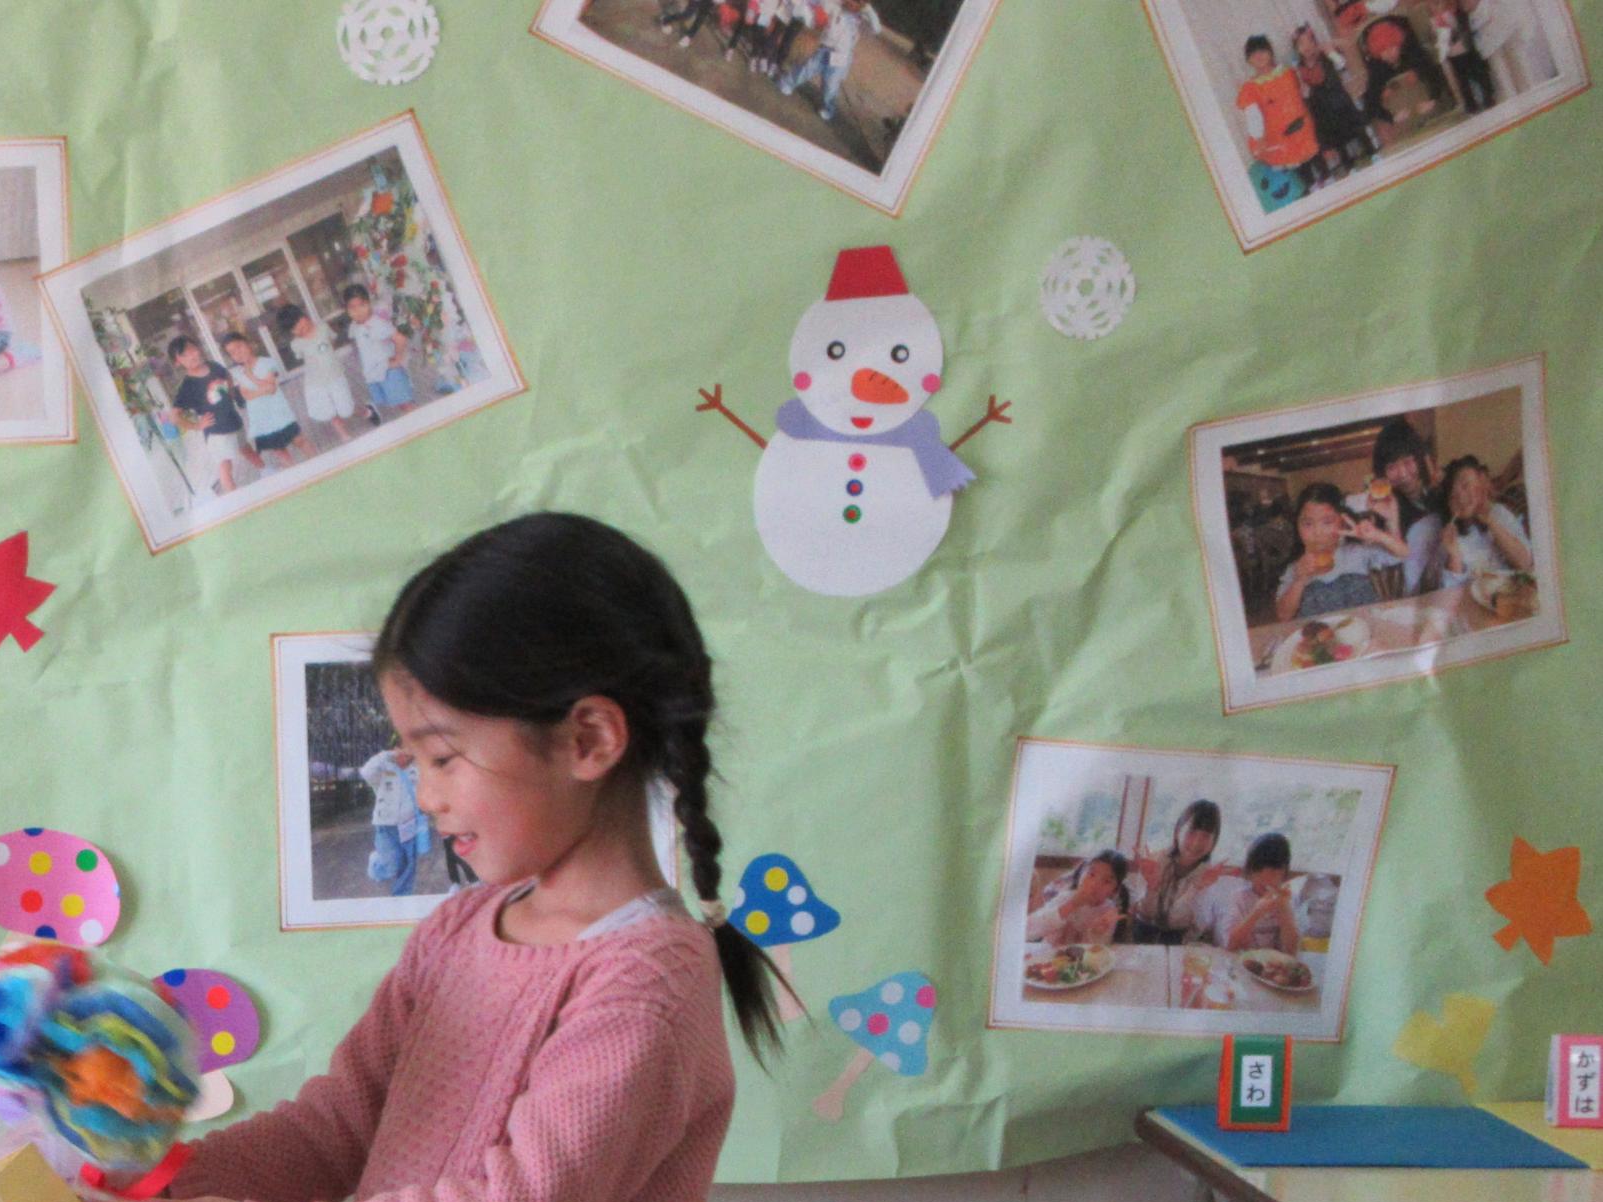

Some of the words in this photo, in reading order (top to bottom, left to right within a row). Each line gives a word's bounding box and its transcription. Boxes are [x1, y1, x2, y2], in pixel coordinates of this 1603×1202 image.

[1246, 1060, 1266, 1102] さわ
[1575, 1050, 1597, 1114] かずは
